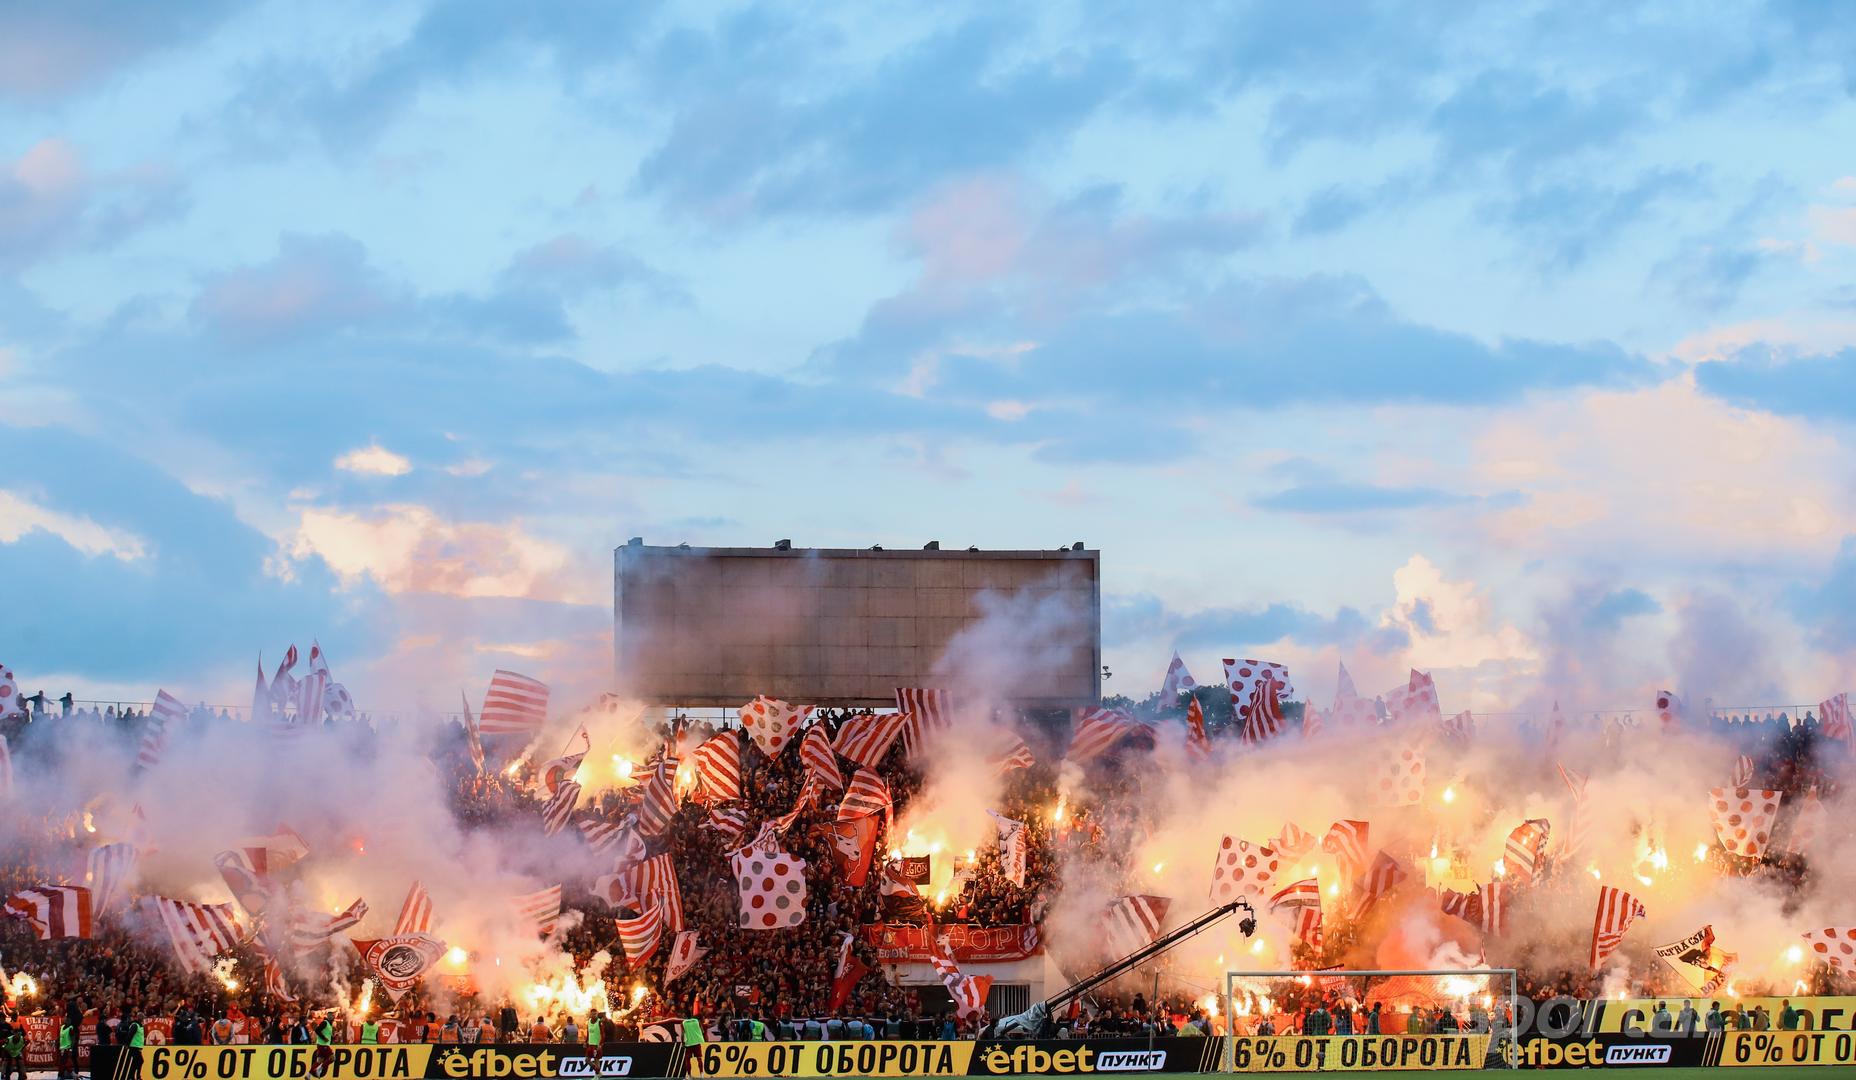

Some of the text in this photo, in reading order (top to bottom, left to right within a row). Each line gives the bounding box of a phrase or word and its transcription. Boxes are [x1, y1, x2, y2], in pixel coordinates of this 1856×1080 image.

[1688, 927, 1710, 945] CSKA
[1700, 971, 1725, 994] BOYS
[704, 1044, 953, 1074] 6% ОТ ОБОРОТА
[986, 1044, 1094, 1074] efbet
[1100, 1054, 1162, 1067] ПУНКТ
[1235, 1037, 1471, 1068] 6% ОТ ОБОРОТА
[1503, 1038, 1604, 1066] efbet
[1610, 1047, 1667, 1060] ПУНКТ
[1736, 1033, 1856, 1062] 6% ОТ О
[152, 1048, 207, 1079] 6%
[217, 1048, 256, 1079] ОТ
[444, 1048, 557, 1078] efbet
[563, 1059, 628, 1072] ПУКТ
